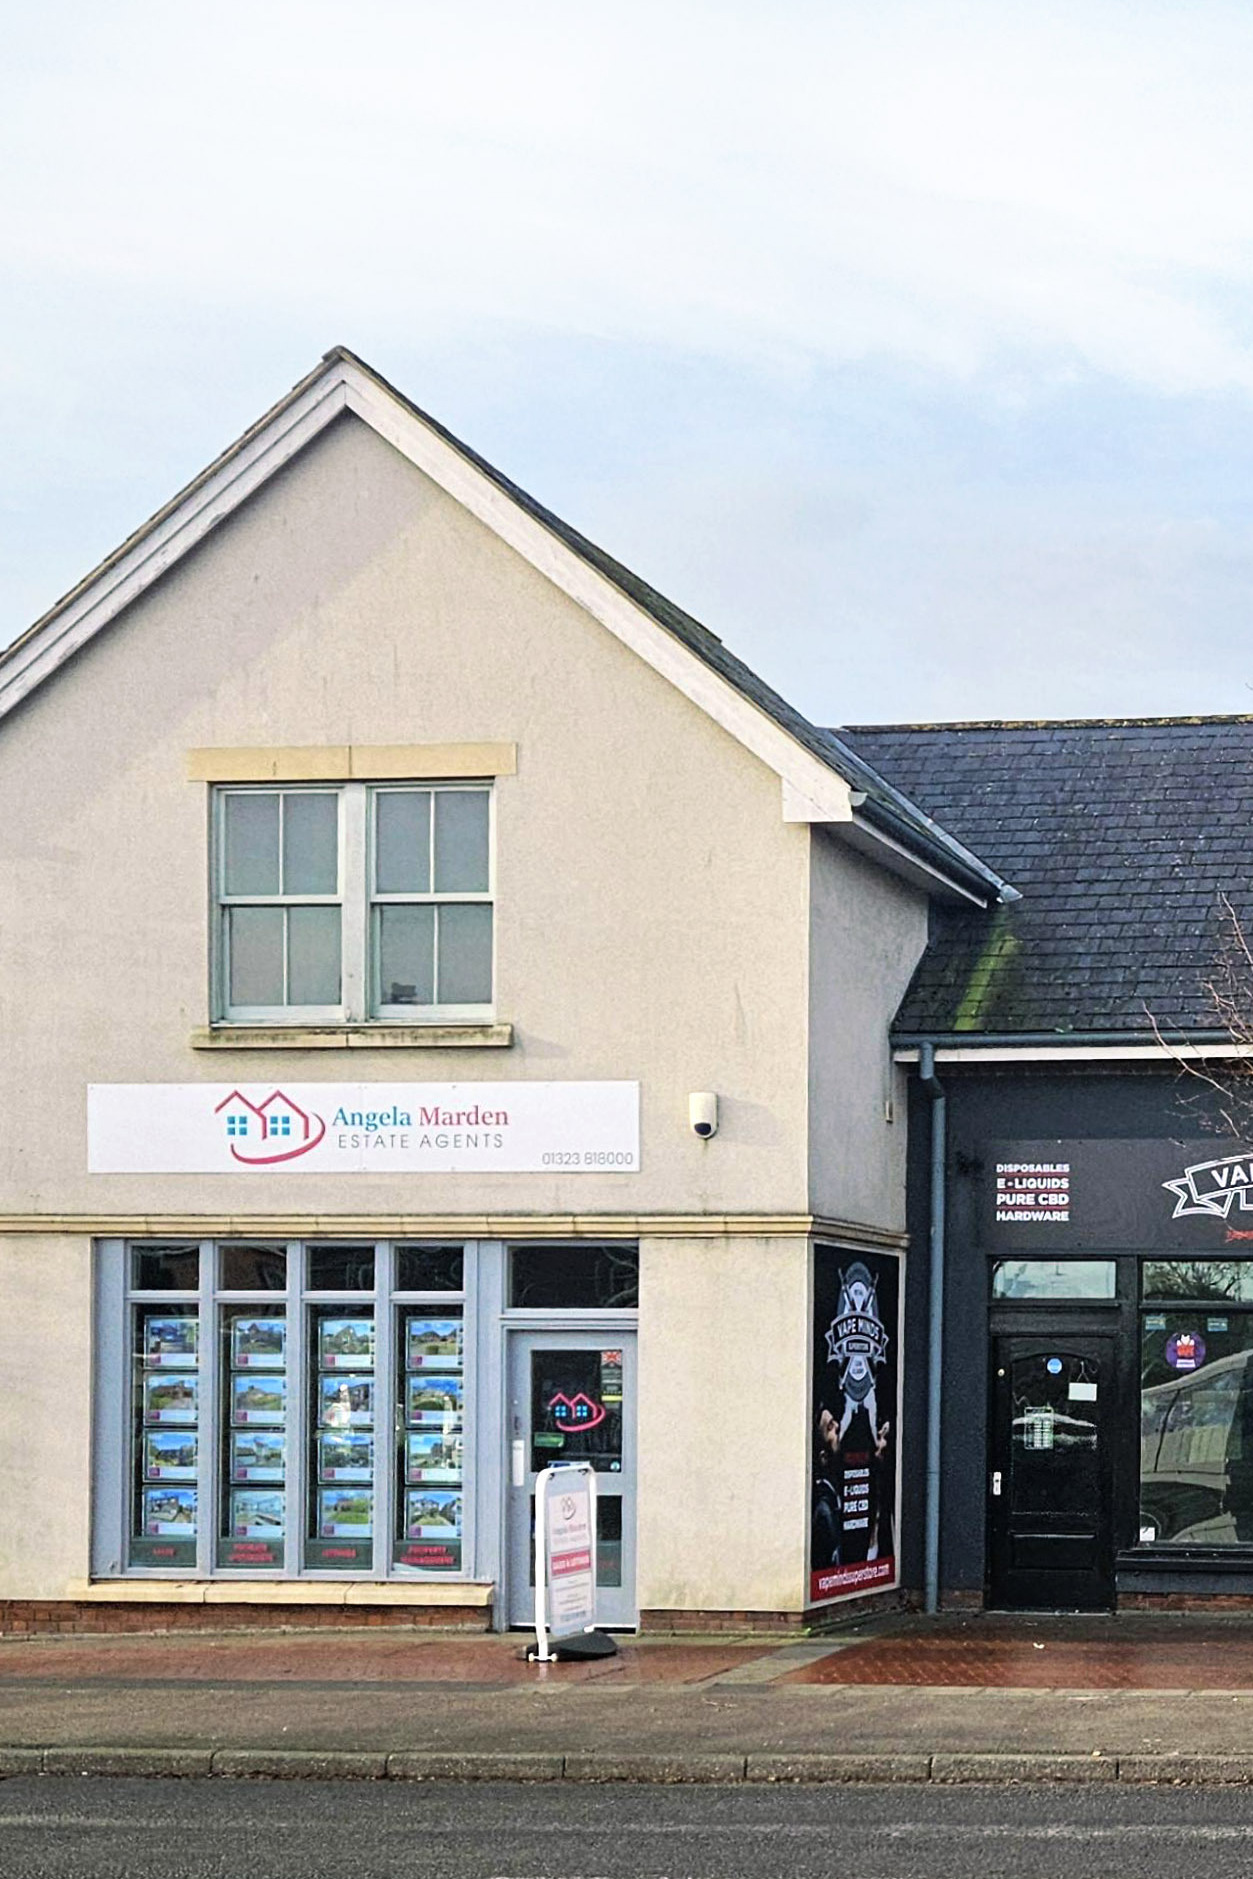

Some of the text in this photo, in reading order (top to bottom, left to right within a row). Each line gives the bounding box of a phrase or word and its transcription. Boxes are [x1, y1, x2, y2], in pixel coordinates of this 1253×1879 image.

[332, 1105, 509, 1132] Angela Marden
[338, 1133, 504, 1149] ESTATE AGENTS
[542, 1152, 633, 1165] 01323 818000
[996, 1163, 1070, 1173] DISPOSABLES
[996, 1193, 1070, 1206] PURE CBD
[996, 1210, 1070, 1221] HARDWARE
[837, 1318, 856, 1338] VAPE
